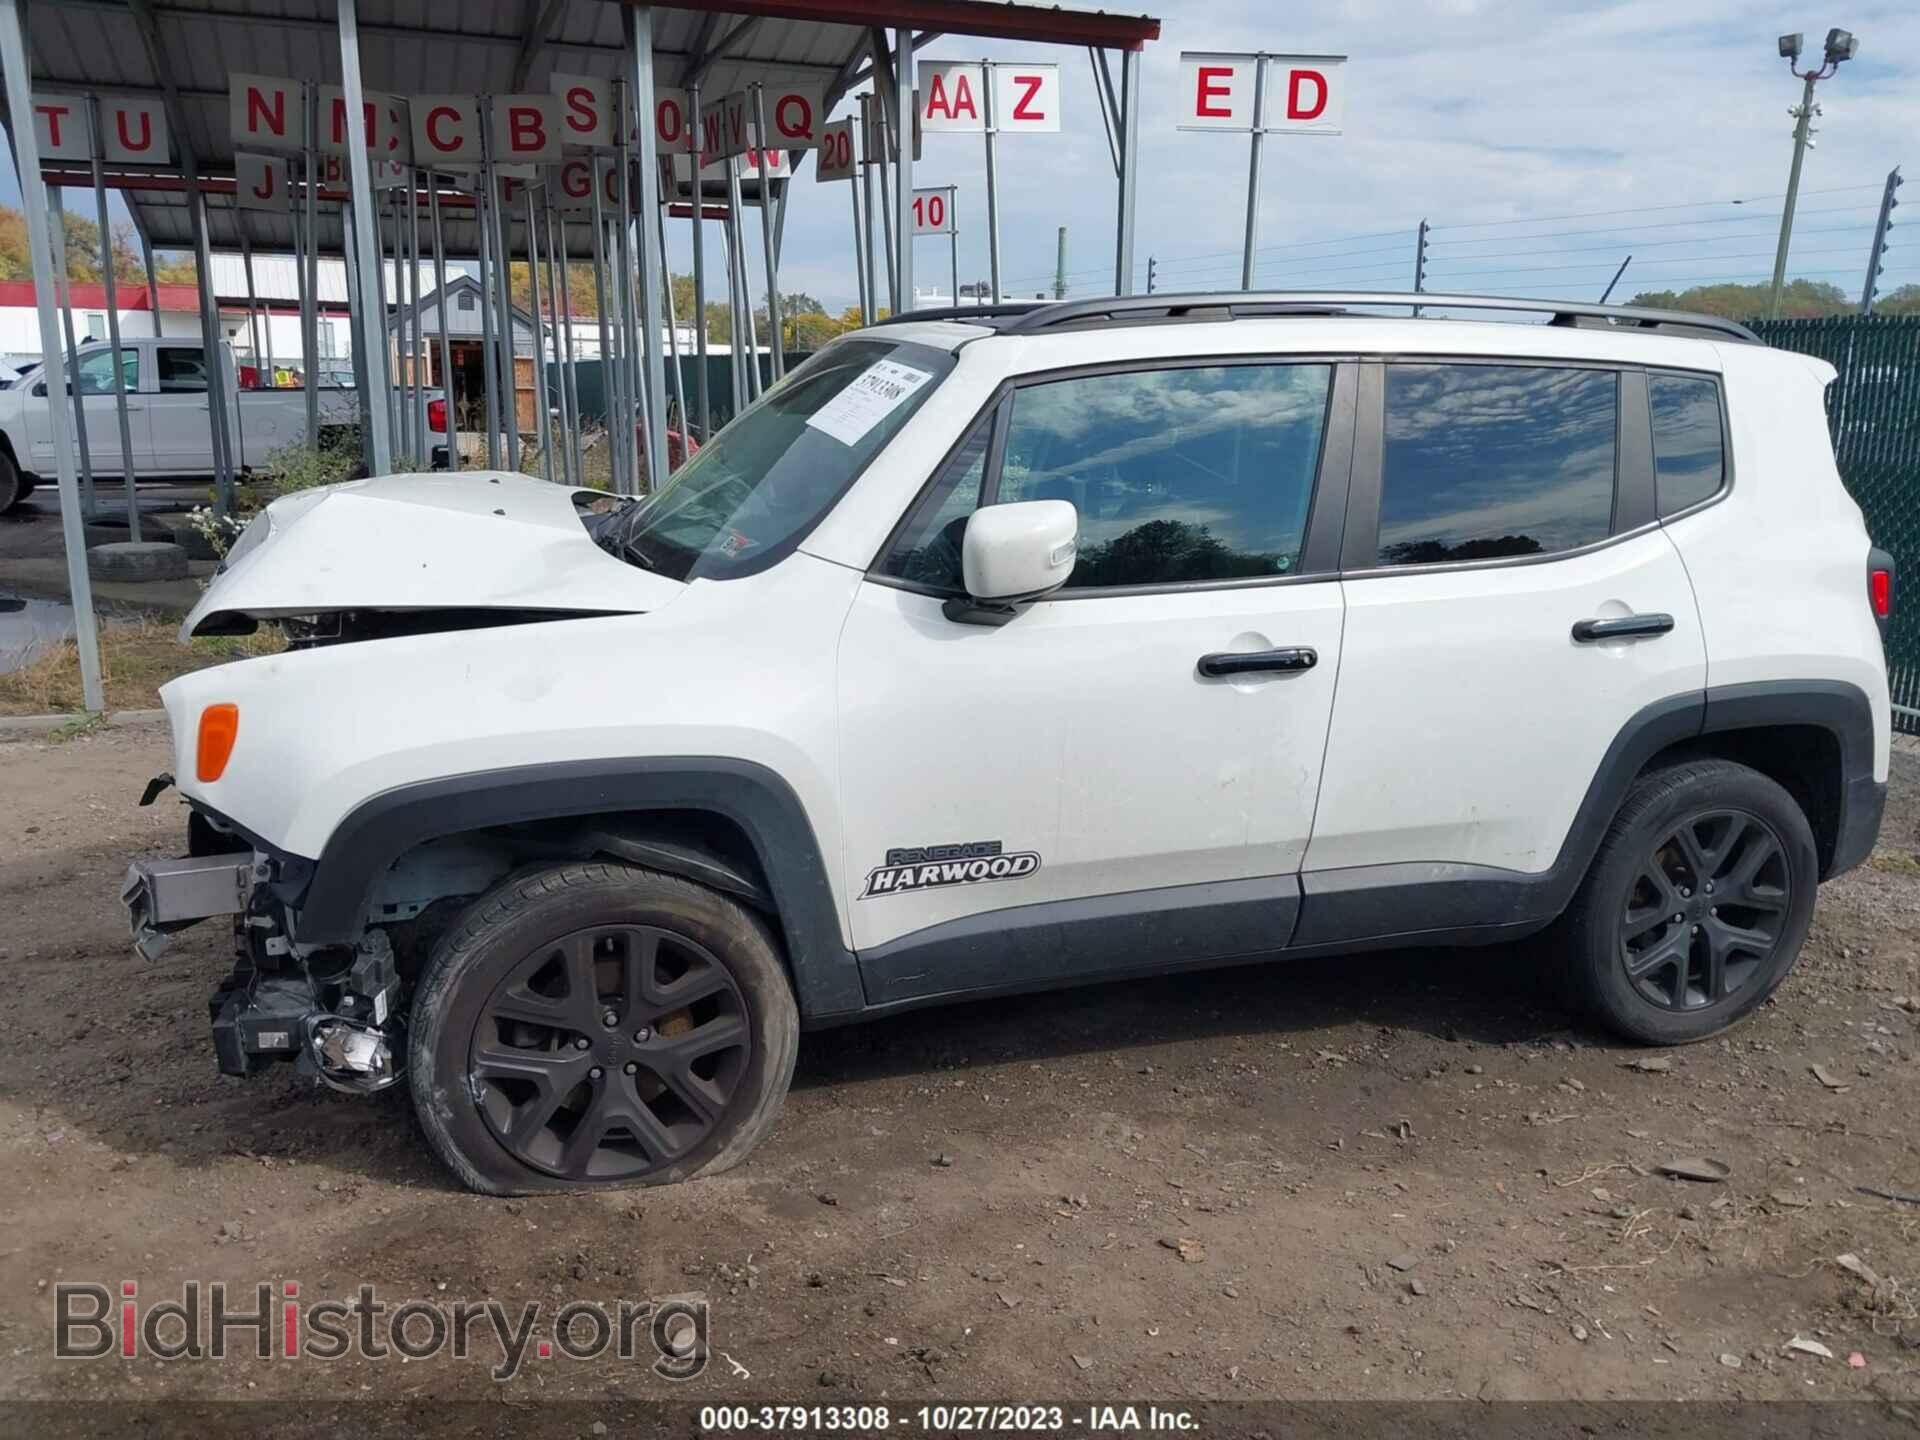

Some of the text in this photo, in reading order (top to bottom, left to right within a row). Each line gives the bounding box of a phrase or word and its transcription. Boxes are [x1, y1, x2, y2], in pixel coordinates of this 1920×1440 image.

[247, 86, 285, 136] N
[566, 87, 598, 132] S
[926, 74, 978, 119] AA
[1013, 76, 1045, 120] Z
[1196, 66, 1234, 118] E
[1286, 70, 1329, 120] D
[34, 105, 69, 147] T
[116, 110, 151, 152] U
[426, 106, 464, 152] C
[509, 107, 546, 152] B
[776, 94, 813, 141] Q
[820, 131, 850, 170] 20
[253, 164, 273, 199] J
[561, 161, 593, 198] G
[912, 196, 944, 227] 10
[872, 855, 1036, 891] HARWOOD
[888, 841, 1001, 864] RENEGADE
